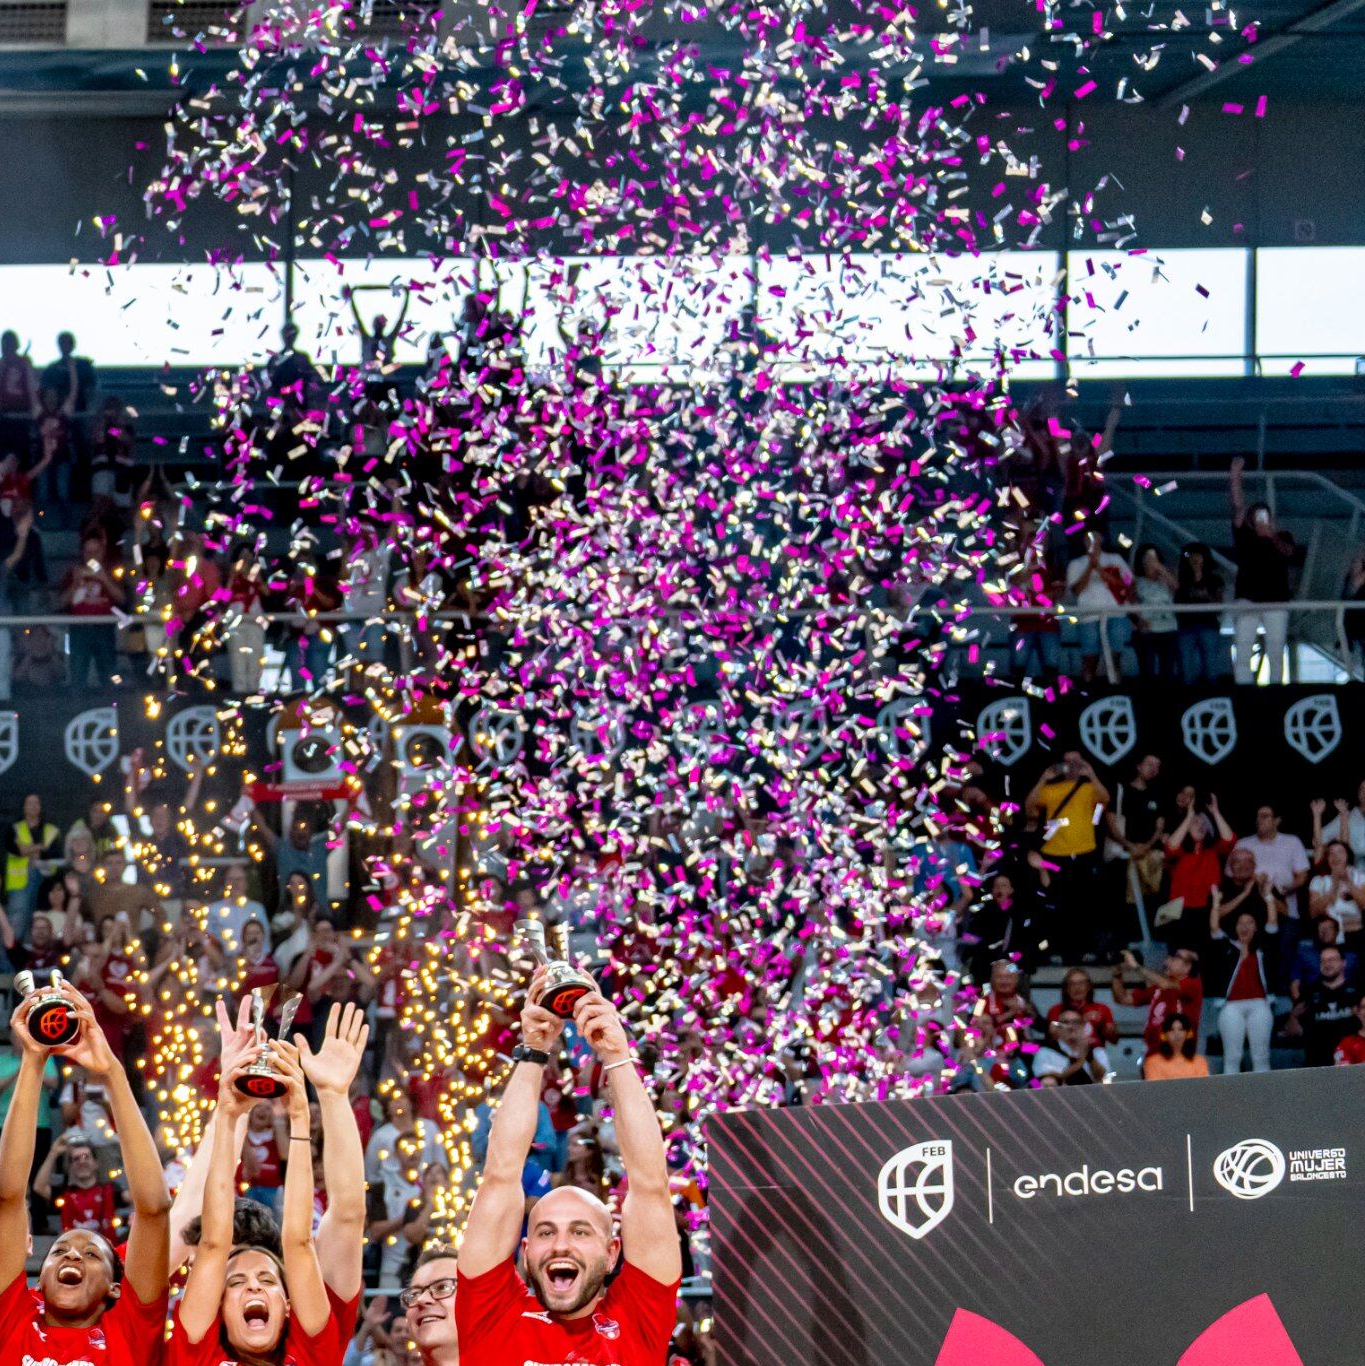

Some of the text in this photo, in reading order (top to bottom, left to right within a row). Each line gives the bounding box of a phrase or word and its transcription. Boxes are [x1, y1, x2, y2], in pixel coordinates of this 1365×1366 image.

[922, 1146, 946, 1157] FEB
[1289, 1148, 1346, 1160] UNIVERSO
[1290, 1158, 1346, 1172] MUJER
[1013, 1165, 1163, 1198] endesa
[1290, 1170, 1347, 1181] BALONCESTO
